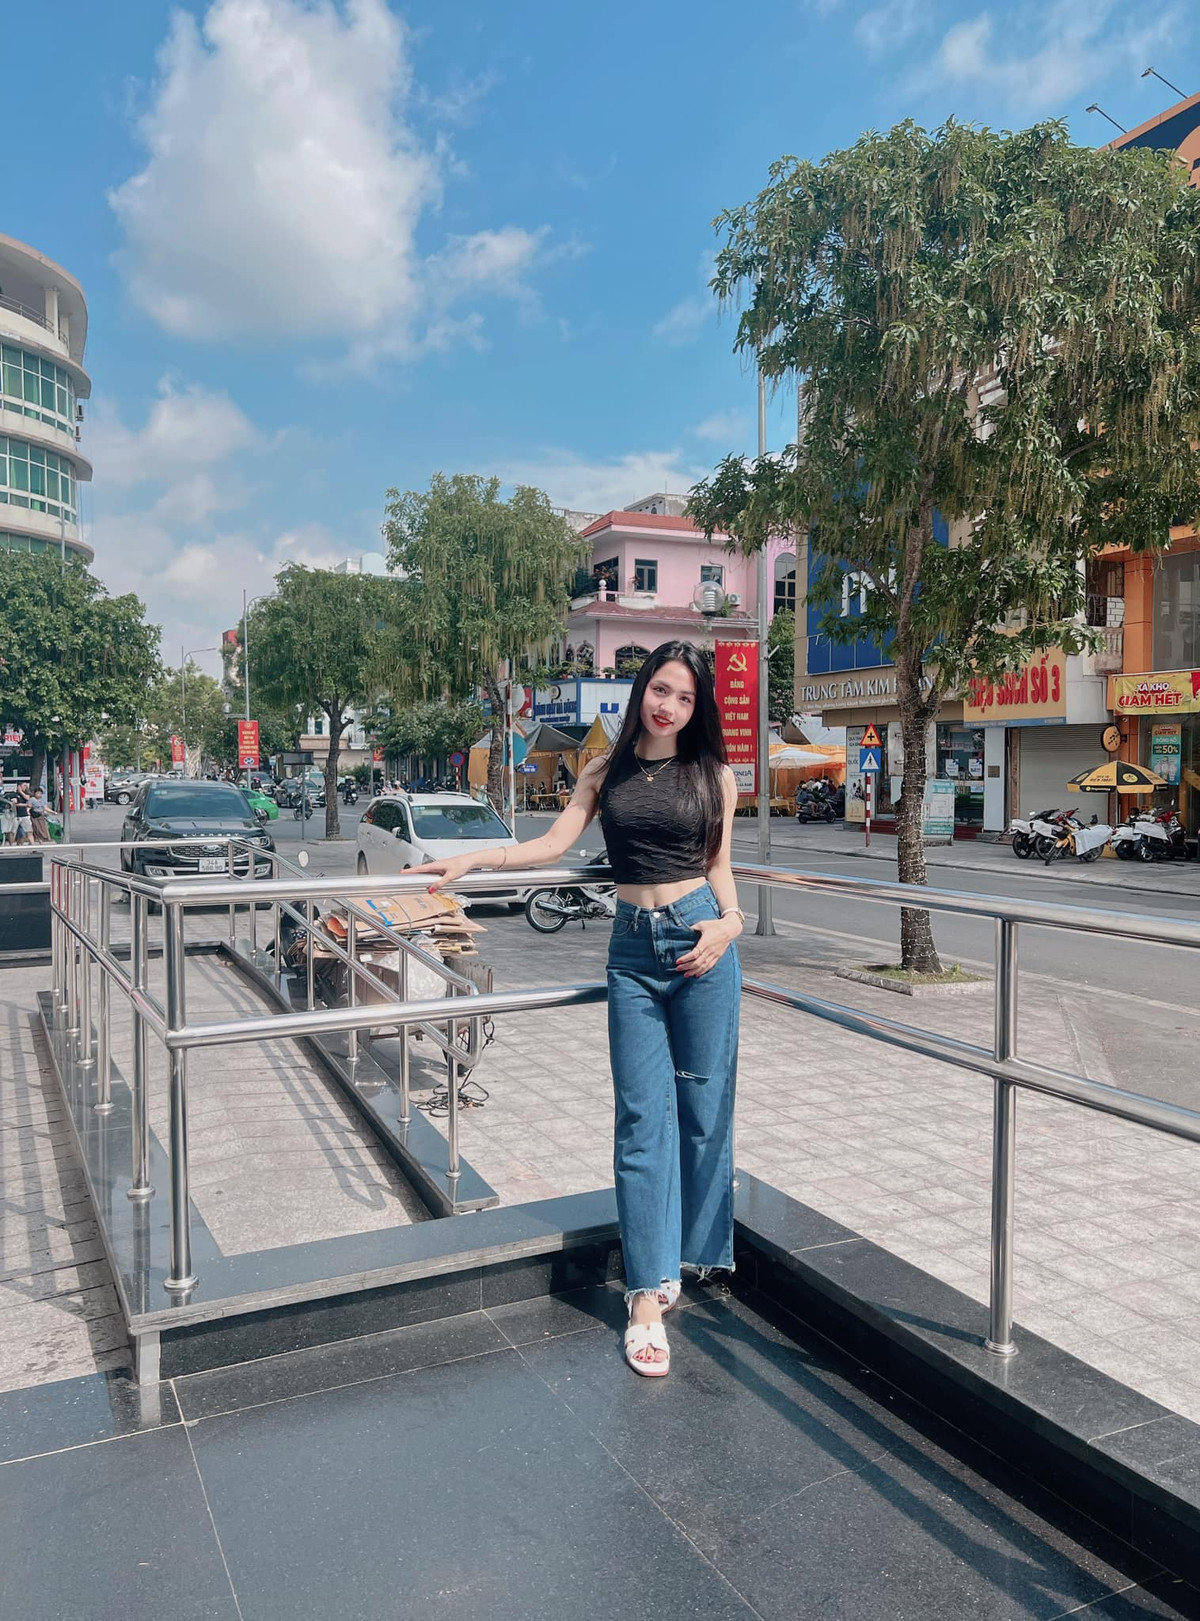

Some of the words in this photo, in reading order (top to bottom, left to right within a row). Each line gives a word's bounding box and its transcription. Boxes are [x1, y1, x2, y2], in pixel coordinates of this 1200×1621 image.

[1031, 654, 1049, 703] SỐ
[1051, 664, 1061, 703] 3
[801, 682, 838, 702] TRUNG
[841, 678, 864, 698] TÂM
[867, 677, 891, 697] KIM
[1149, 682, 1170, 692] KHO
[724, 696, 739, 706] CỘNG
[739, 694, 750, 705] SẢN
[1118, 691, 1152, 707] GIẢM
[1154, 688, 1182, 706] HẾT
[725, 712, 736, 722] VIỆT
[736, 712, 749, 721] NAM
[737, 743, 749, 753] NĂM
[1162, 744, 1179, 754] 50%
